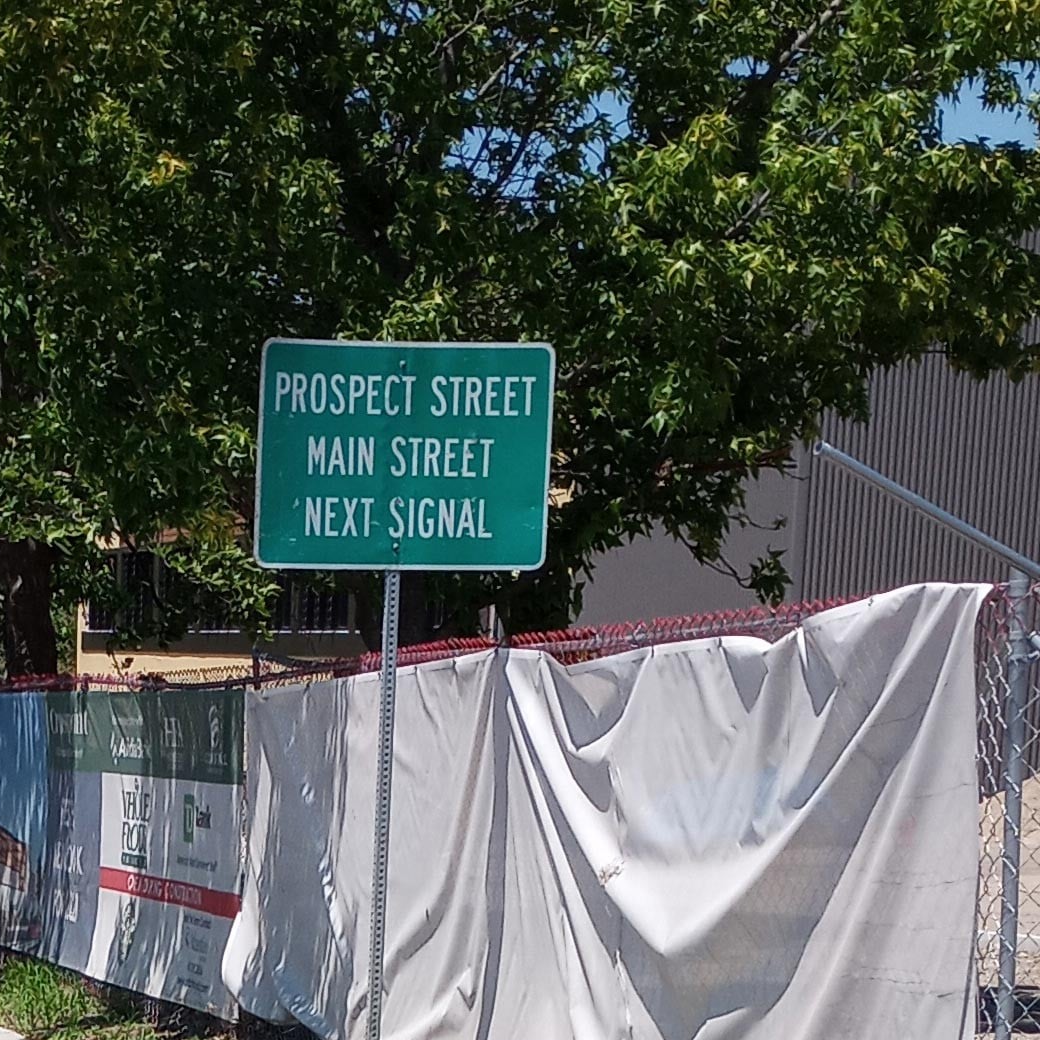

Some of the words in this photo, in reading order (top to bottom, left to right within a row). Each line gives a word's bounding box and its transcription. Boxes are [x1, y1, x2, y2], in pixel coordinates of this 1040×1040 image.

[274, 371, 417, 416] PROSPECT
[430, 375, 536, 417] STREET
[307, 435, 375, 476] MAIN
[390, 435, 495, 478] STREET
[304, 496, 375, 537] NEXT
[388, 496, 493, 539] SIGNAL
